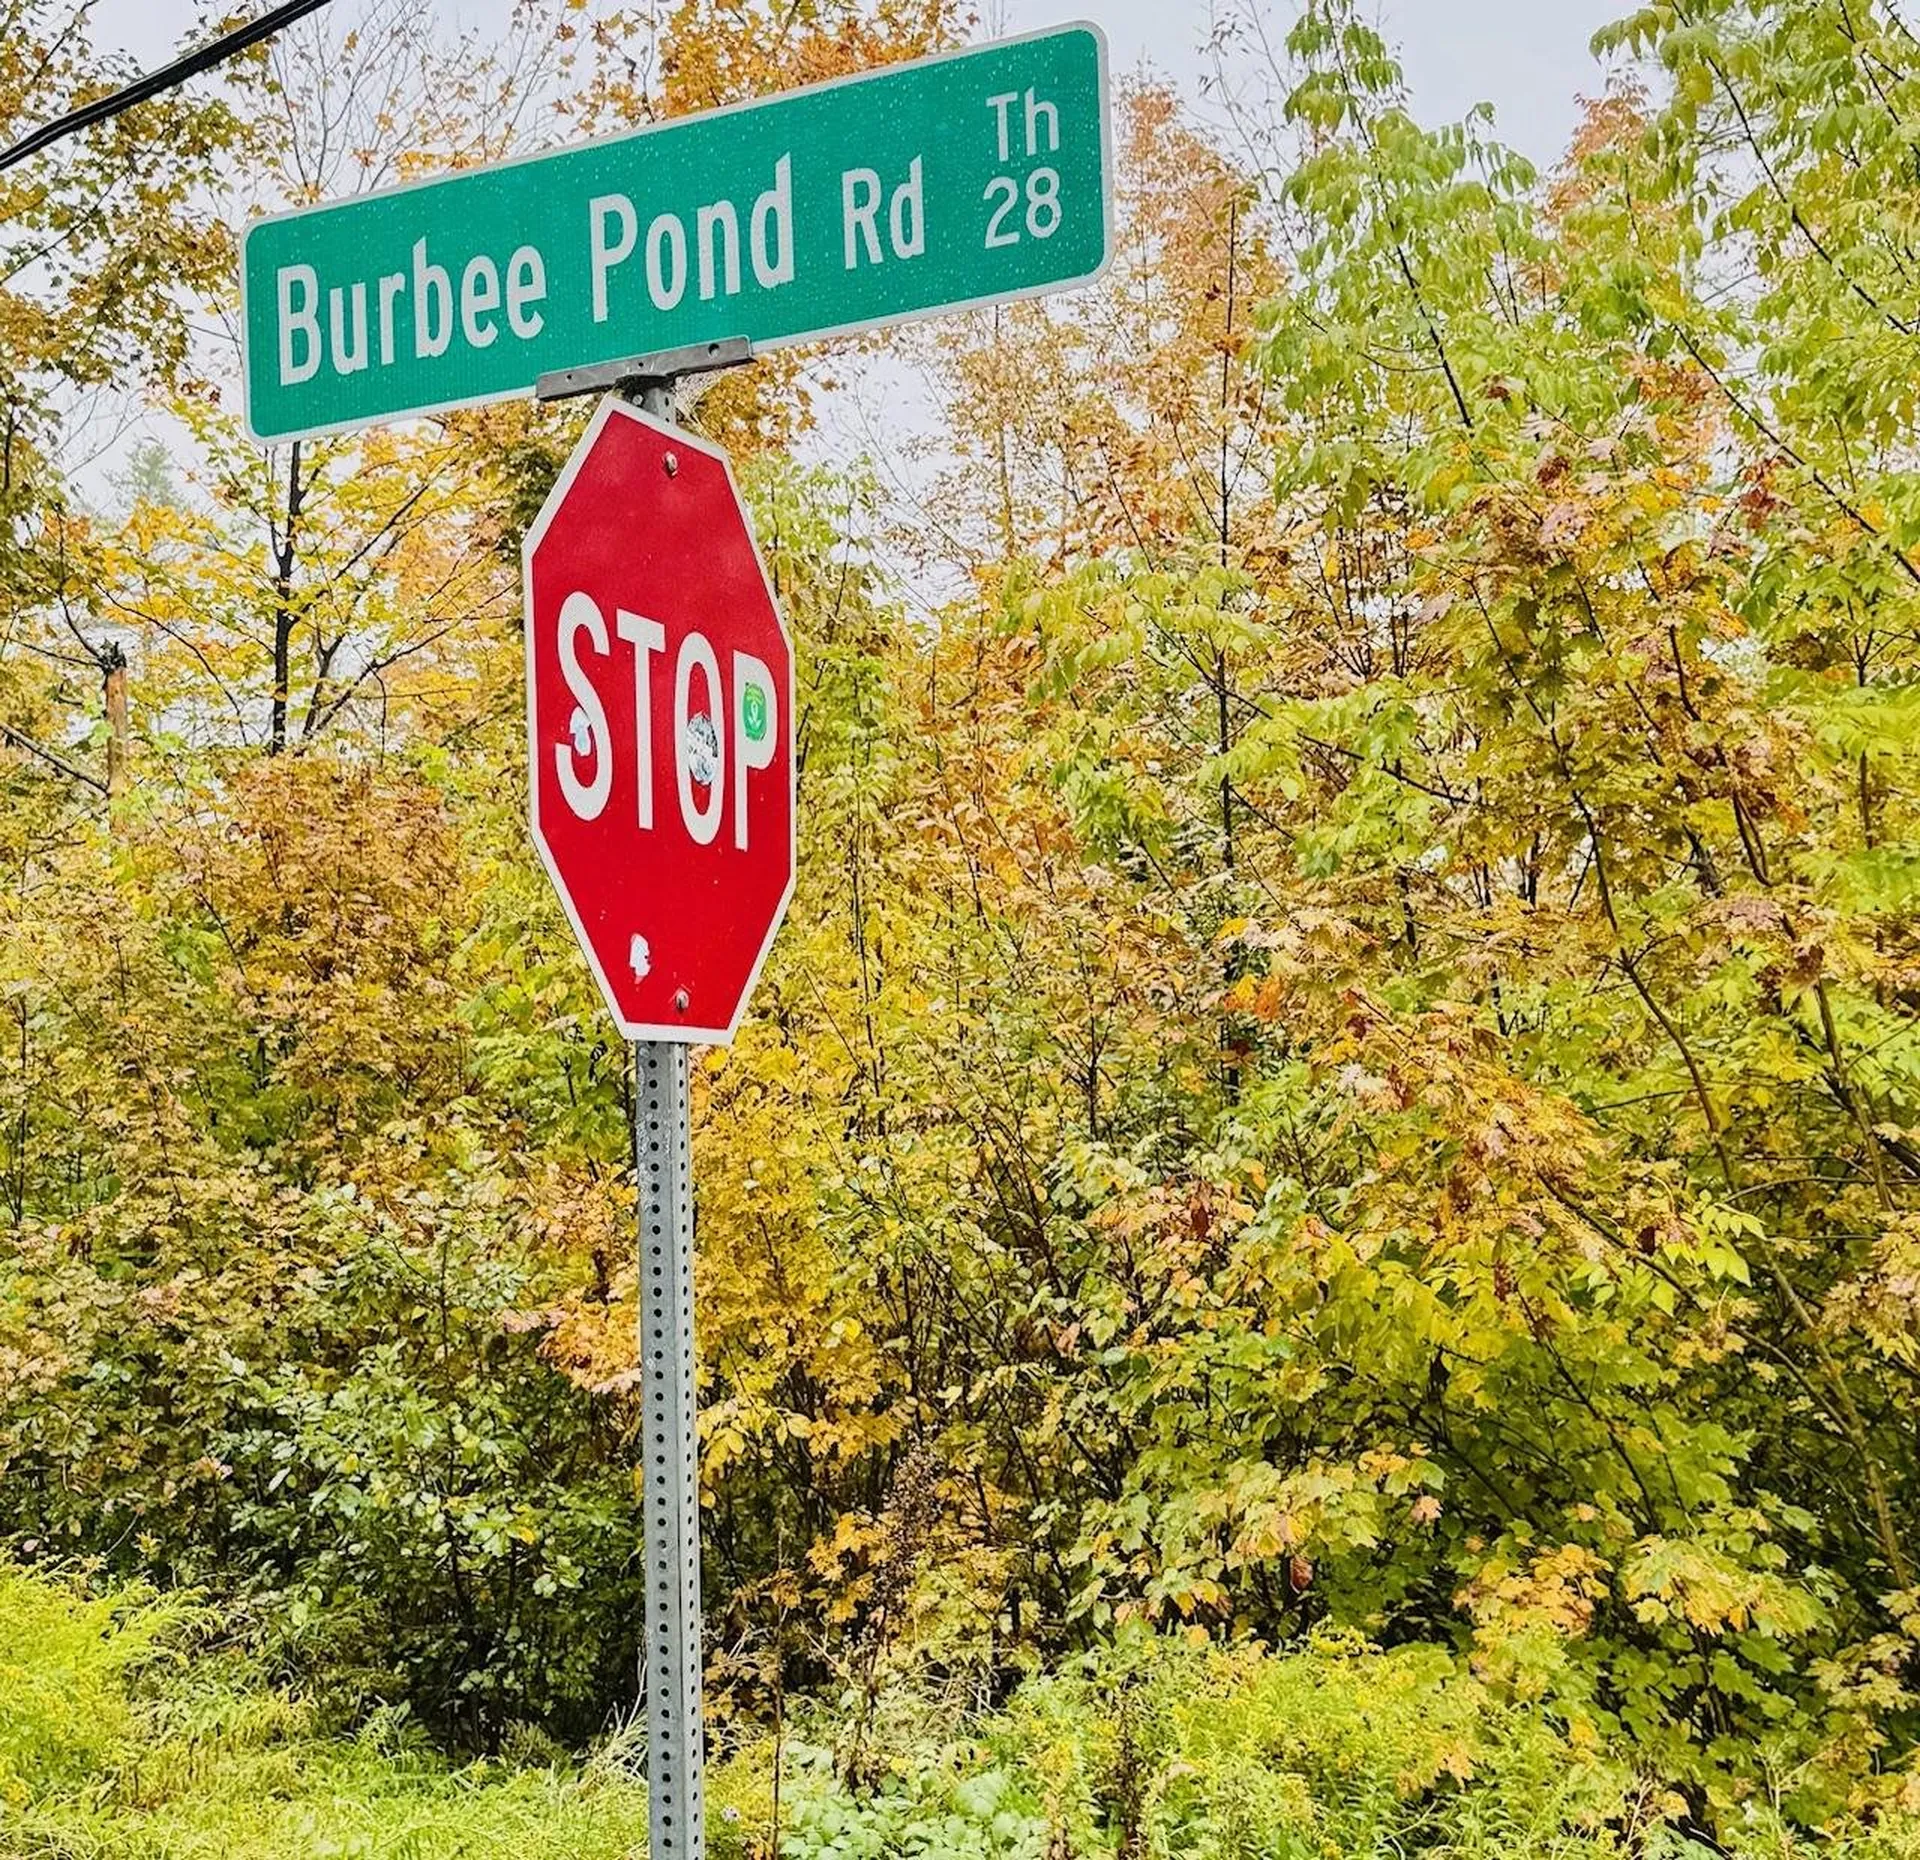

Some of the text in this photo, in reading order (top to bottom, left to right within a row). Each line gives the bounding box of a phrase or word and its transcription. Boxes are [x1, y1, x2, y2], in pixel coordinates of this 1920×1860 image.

[985, 86, 1061, 162] Th
[277, 151, 926, 388] Burbee Pond Rd
[983, 167, 1063, 250] 28
[555, 590, 779, 852] STOP
